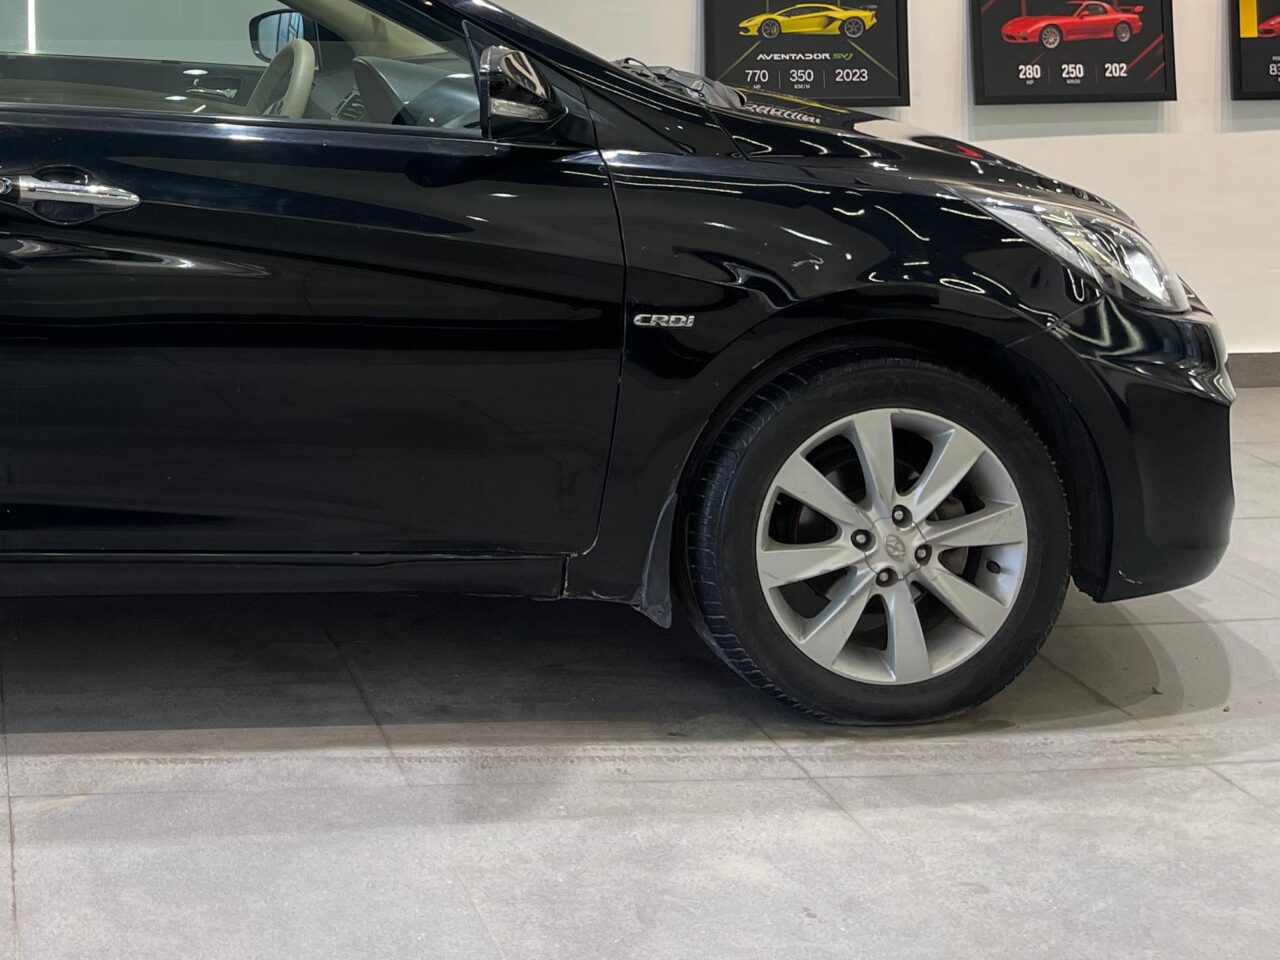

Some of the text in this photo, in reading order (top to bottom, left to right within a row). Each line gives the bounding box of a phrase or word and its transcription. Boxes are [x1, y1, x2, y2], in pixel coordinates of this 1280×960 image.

[745, 69, 868, 82] 770 350 2023
[1018, 63, 1128, 79] 280 250 202
[633, 313, 695, 327] CRDi
